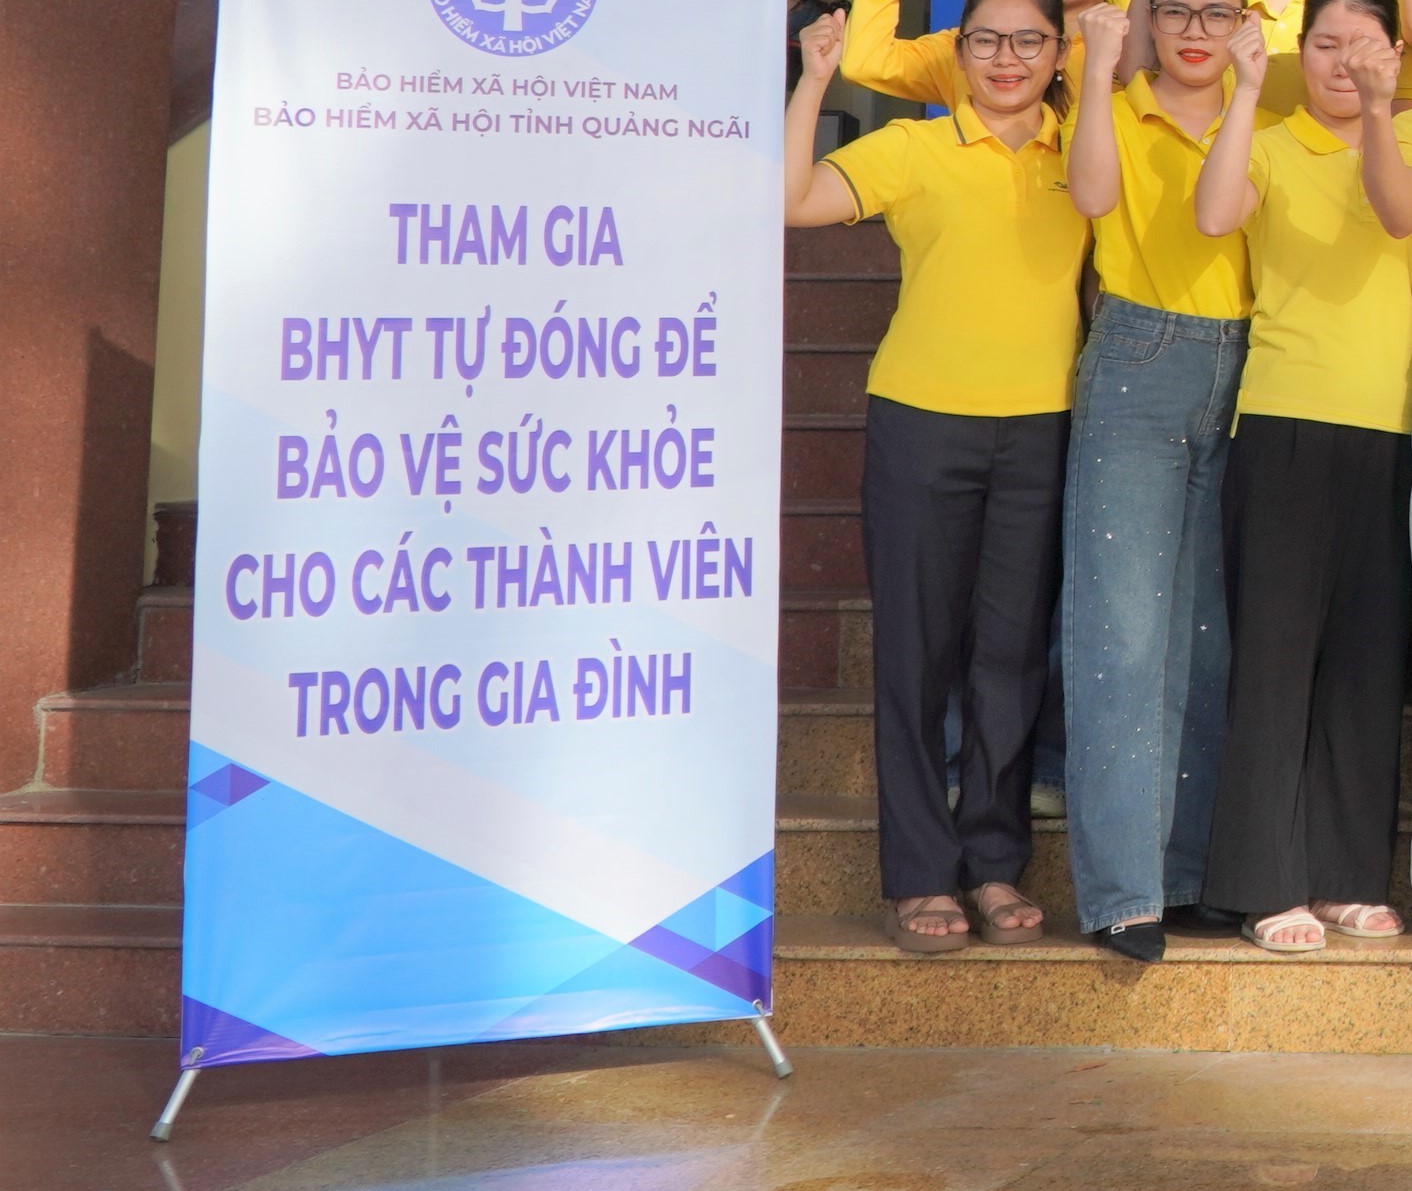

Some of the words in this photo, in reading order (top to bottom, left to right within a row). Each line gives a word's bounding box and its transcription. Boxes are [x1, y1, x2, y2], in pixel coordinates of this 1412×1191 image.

[441, 6, 480, 43] HIỂM
[479, 34, 506, 53] XÃ
[509, 36, 543, 54] HỘI
[542, 16, 579, 45] VIỆT
[253, 100, 315, 128] BẢO
[325, 102, 398, 131] HIỂM
[406, 109, 443, 131] XÃ
[452, 111, 500, 138] HỘI
[509, 108, 573, 135] TỈNH
[582, 111, 679, 141] QUẢNG
[688, 115, 750, 139] NGÃI
[337, 67, 391, 92] BẢO
[401, 69, 463, 95] HIỂM
[471, 72, 504, 96] XÃ
[513, 75, 555, 100] HỘI
[564, 78, 615, 103] VIỆT
[624, 82, 678, 100] NAM
[389, 203, 527, 265] THAM
[544, 205, 624, 267] GIA
[280, 317, 412, 380] BHYT
[426, 304, 491, 399] TỰ
[501, 300, 641, 379] ĐÓNG
[655, 291, 716, 377] ĐỂ
[277, 409, 384, 499] BẢO
[400, 414, 461, 514] VỆ
[477, 413, 572, 494] SỨC
[587, 404, 714, 491] KHỎE
[226, 551, 336, 620] CHO
[352, 531, 452, 615] CÁC
[467, 527, 632, 610] THÀNH
[647, 521, 753, 601] VIÊN
[288, 663, 462, 738] TRONG
[477, 659, 560, 728] GIA
[573, 638, 691, 721] ĐÌNH
